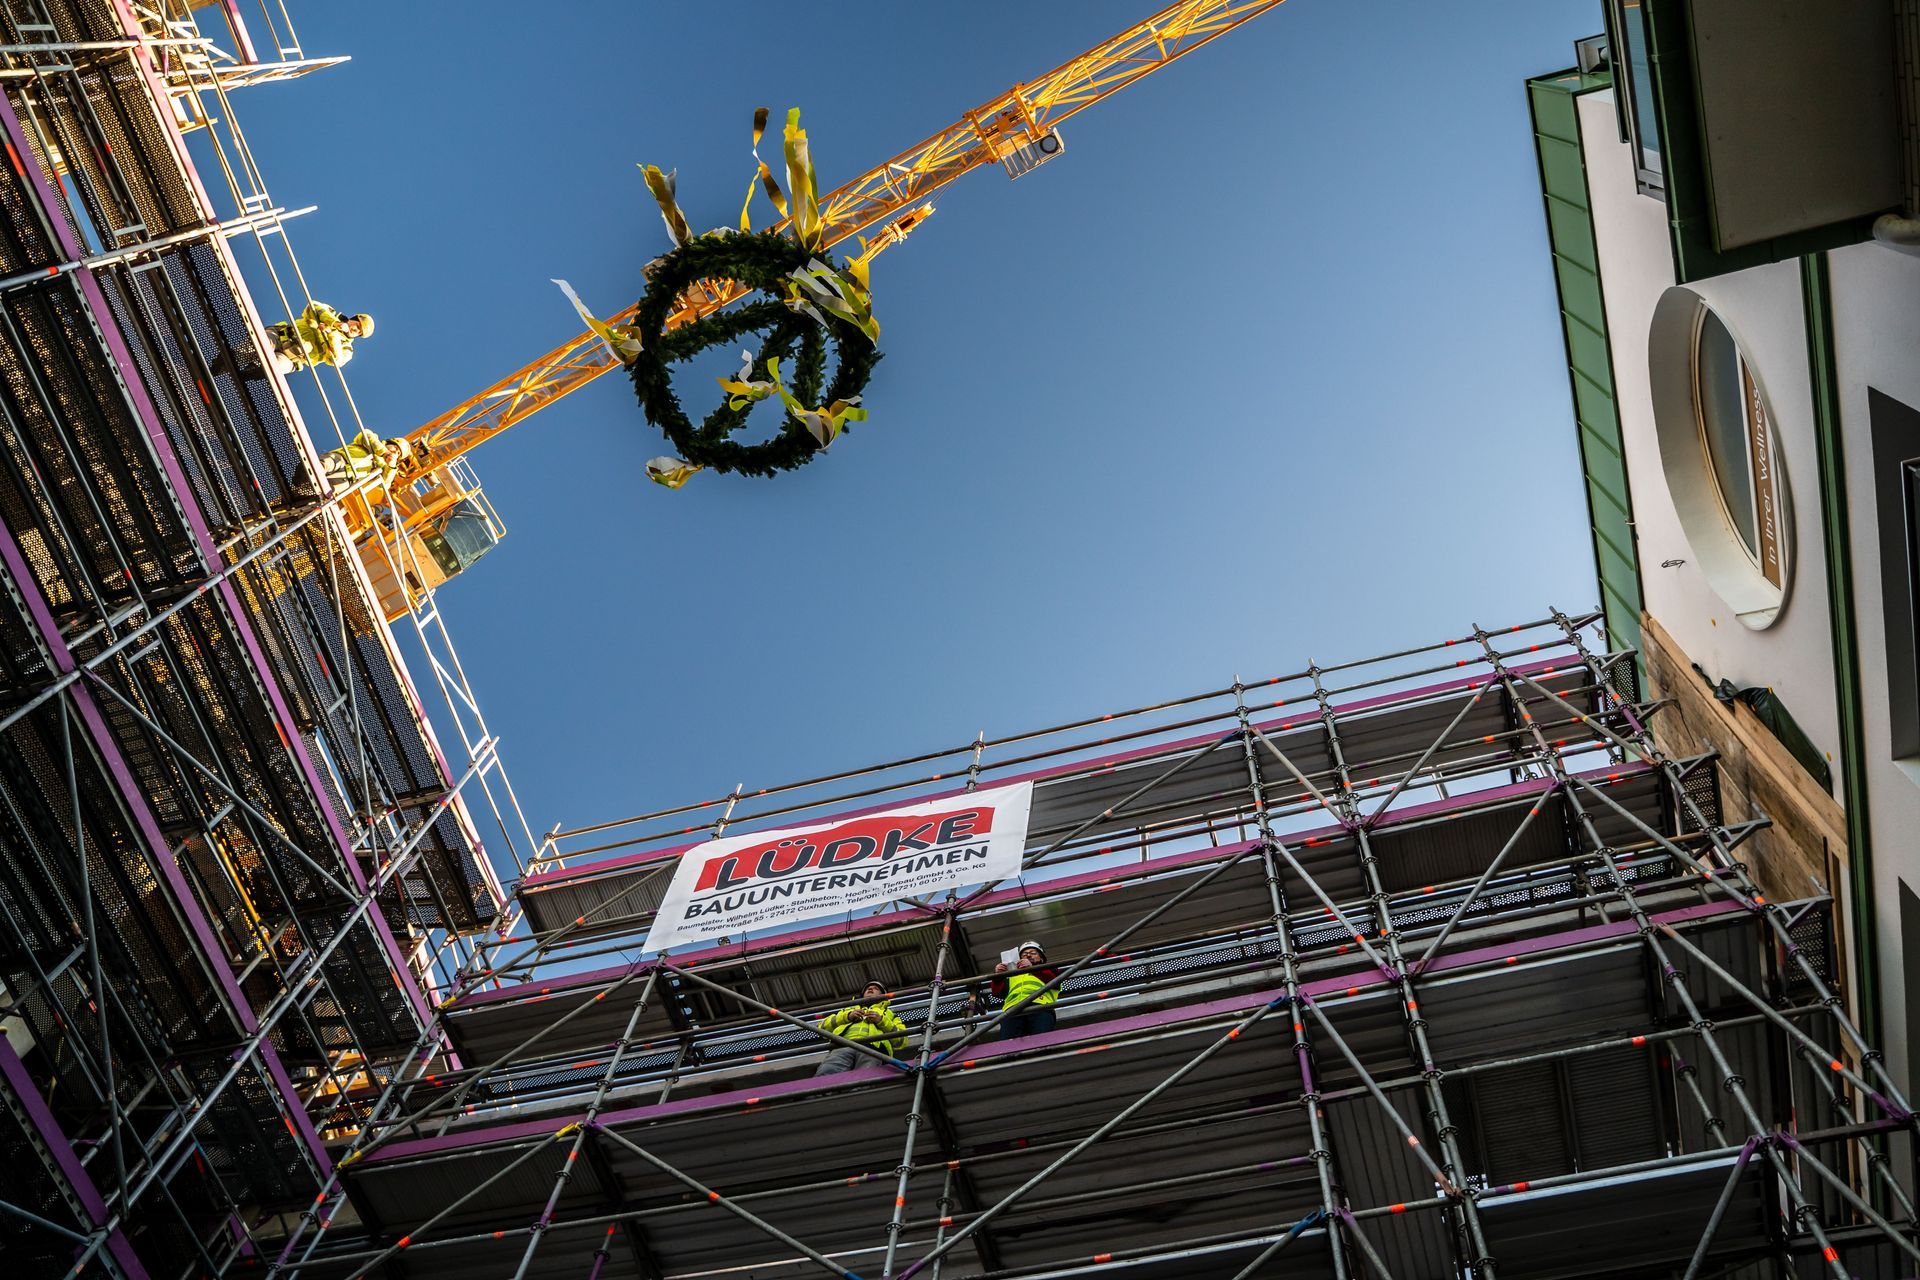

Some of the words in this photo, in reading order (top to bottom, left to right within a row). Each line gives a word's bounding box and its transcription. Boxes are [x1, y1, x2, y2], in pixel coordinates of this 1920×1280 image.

[1753, 388, 1768, 481] Wellness
[1763, 487, 1774, 541] Ihrer
[1768, 546, 1777, 565] In
[715, 810, 979, 891] LÜDKE
[677, 918, 724, 931] Baumeister
[726, 911, 758, 923] Wilhelm
[760, 903, 785, 915] Lüdke
[917, 871, 945, 880] GmbH
[684, 845, 989, 920] BAUUNTERNEHMEN
[700, 919, 753, 933] Meyerstraße
[753, 915, 765, 923] 55
[769, 907, 796, 918] 27472
[797, 901, 840, 912] Cuxhaven
